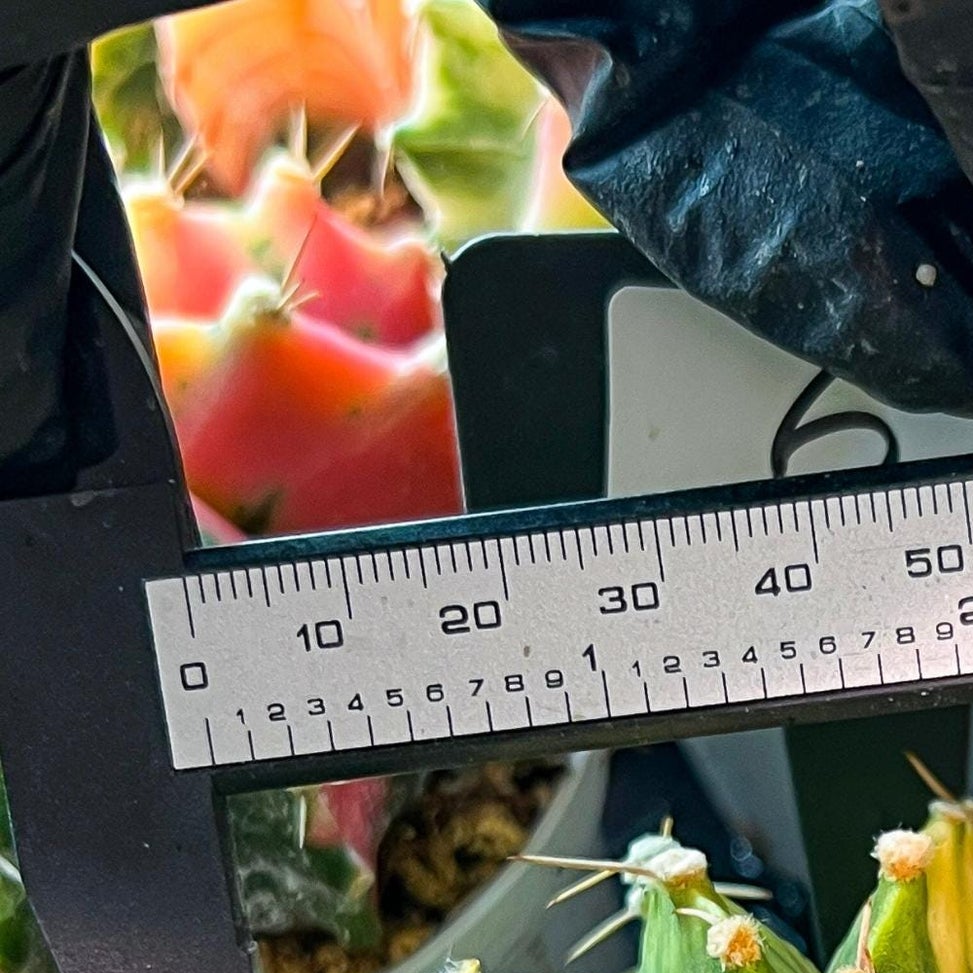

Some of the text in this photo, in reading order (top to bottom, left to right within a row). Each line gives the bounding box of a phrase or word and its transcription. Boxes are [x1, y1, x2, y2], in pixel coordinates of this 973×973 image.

[179, 661, 209, 691] 0
[296, 619, 344, 652] 10
[439, 600, 502, 635] 20
[597, 581, 660, 615] 30
[754, 563, 812, 597] 40
[904, 544, 964, 578] 50
[235, 707, 247, 726] 1
[267, 702, 287, 722] 2
[307, 697, 326, 716] 3
[347, 693, 364, 711] 4
[385, 688, 404, 707] 5
[426, 683, 445, 703] 6
[468, 678, 484, 697] 7
[504, 674, 525, 693] 8
[544, 669, 564, 689] 9
[581, 642, 598, 673] 1
[631, 659, 642, 679] 1
[662, 655, 682, 674] 2
[702, 650, 721, 668] 3
[741, 645, 758, 664] 4
[780, 640, 797, 660] 5
[818, 635, 837, 655] 6
[861, 631, 876, 649] 7
[895, 626, 916, 645] 8
[935, 621, 954, 641] 9
